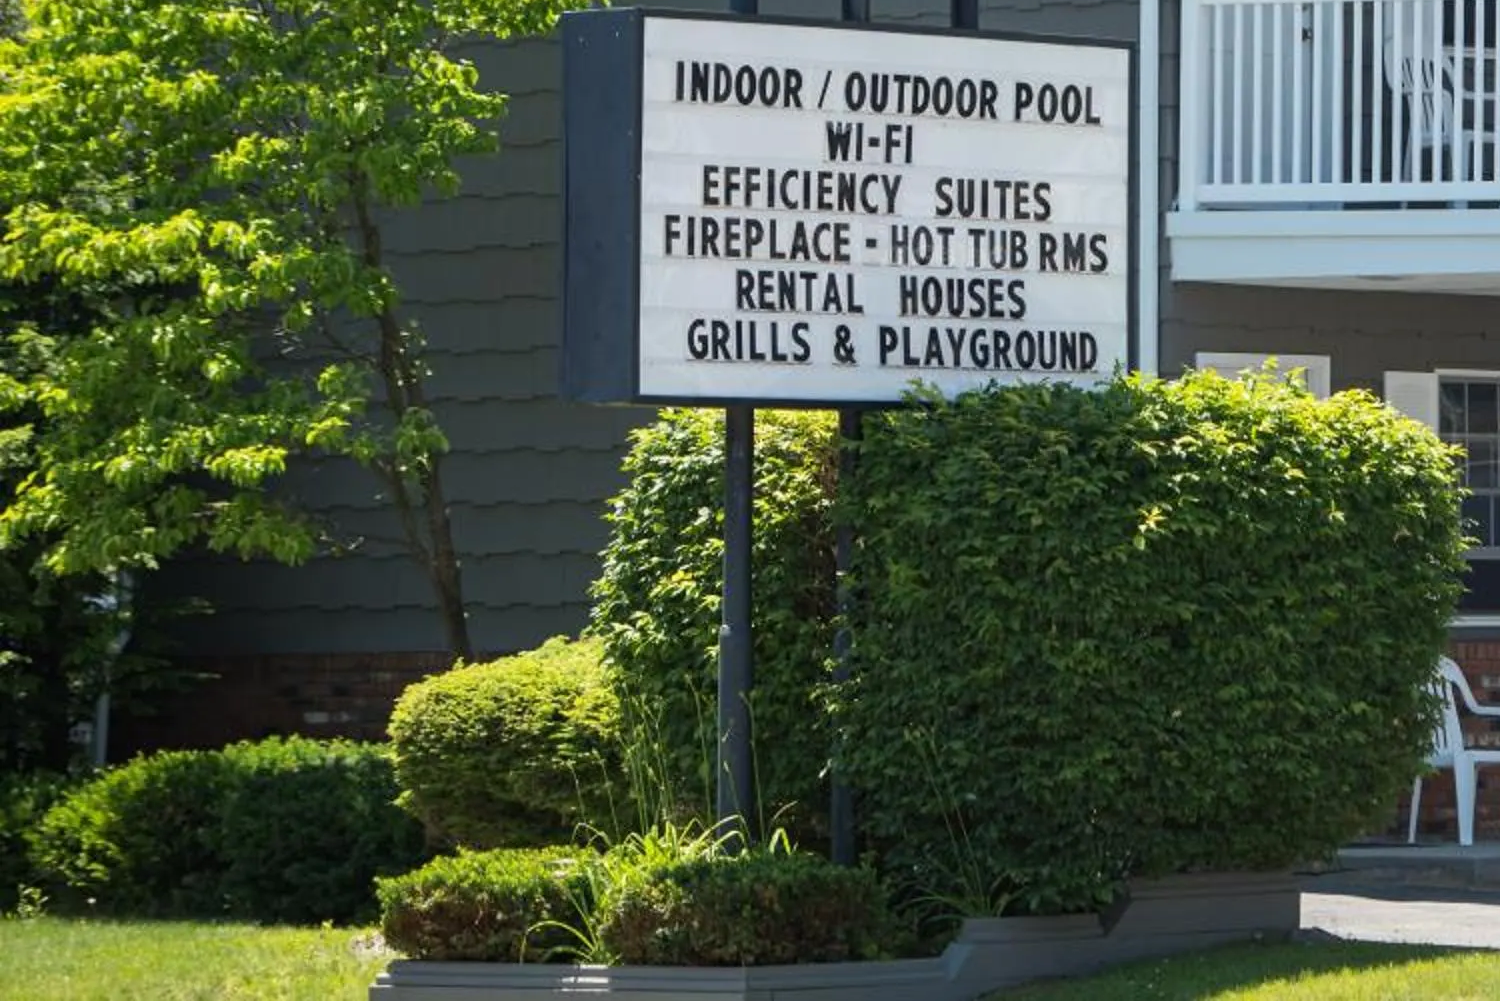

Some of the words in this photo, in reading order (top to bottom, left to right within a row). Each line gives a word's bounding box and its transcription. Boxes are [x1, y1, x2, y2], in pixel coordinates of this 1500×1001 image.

[676, 61, 802, 108] INDOOR
[845, 72, 998, 119] OUTDOOR
[1015, 83, 1100, 125] POOL
[827, 122, 912, 163] WI-FI
[704, 165, 901, 214] EFFICIENCY
[936, 177, 1050, 221] SUITES
[665, 215, 850, 262] FIREPLACE
[892, 225, 954, 265] HOT
[968, 229, 1028, 269] TUB
[1040, 233, 1107, 273] RMS
[737, 270, 863, 313] RENTAL
[900, 276, 1026, 319] HOUSES
[688, 319, 810, 364] GRILLS
[834, 325, 856, 365] &
[880, 326, 1097, 372] PLAYGROUND
